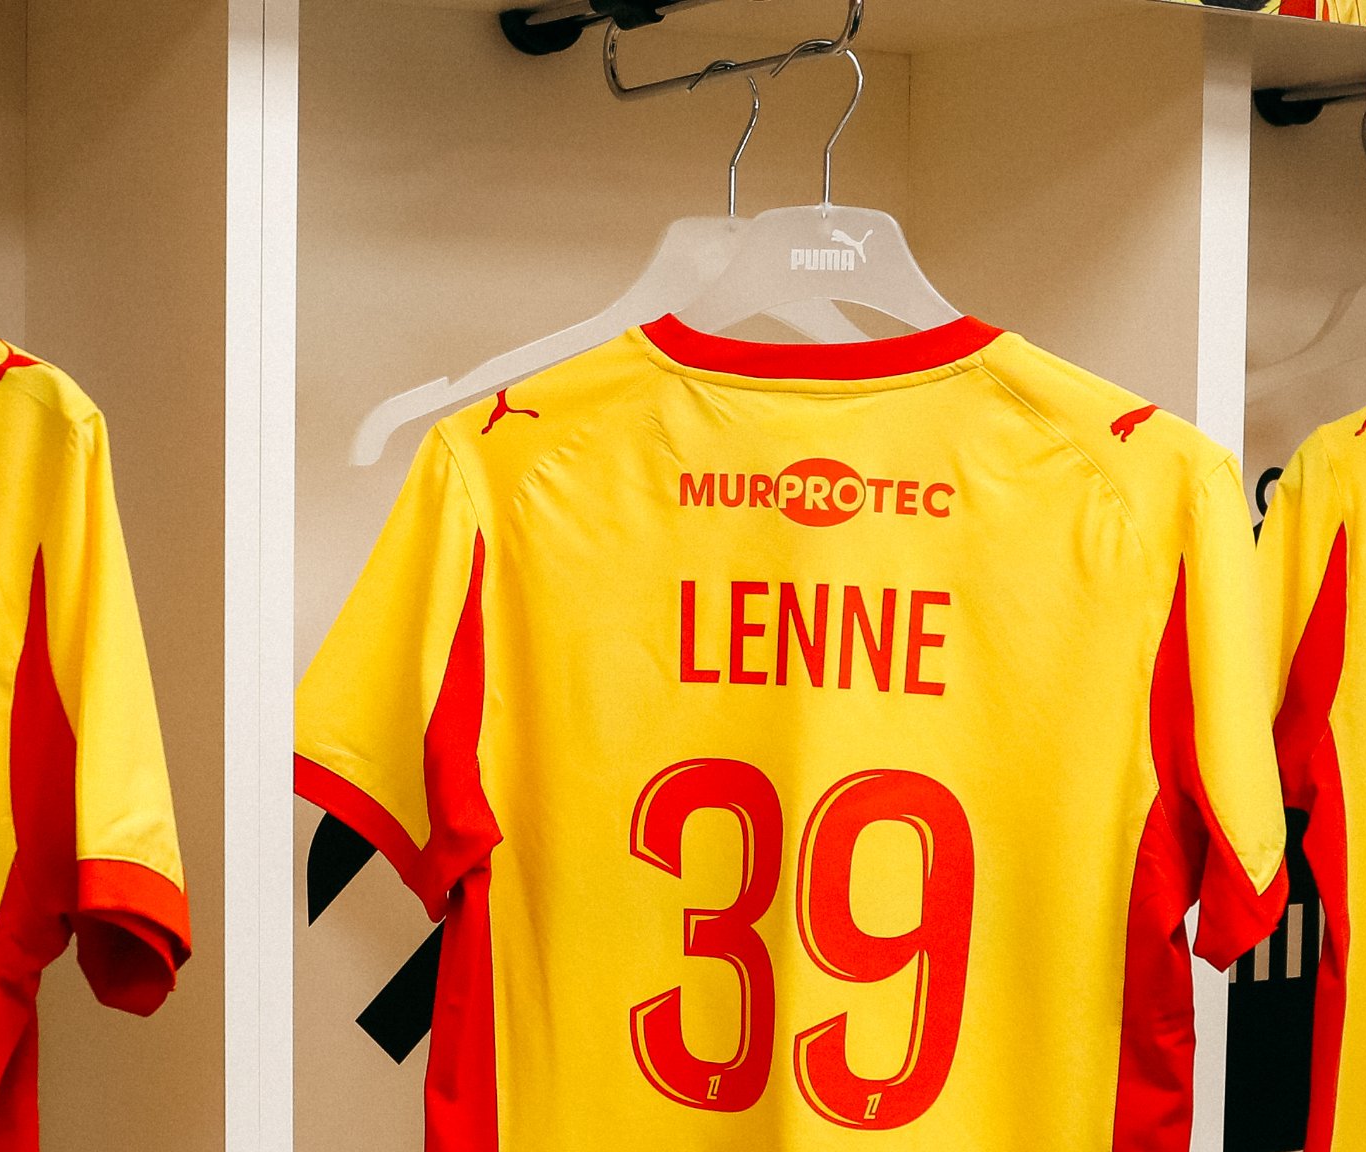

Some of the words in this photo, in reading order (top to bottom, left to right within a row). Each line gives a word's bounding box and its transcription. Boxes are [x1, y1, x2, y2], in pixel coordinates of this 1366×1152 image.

[791, 248, 855, 272] PUMA
[680, 472, 956, 519] MURPROTEC
[680, 580, 951, 696] LENNE
[630, 757, 975, 1131] 39
